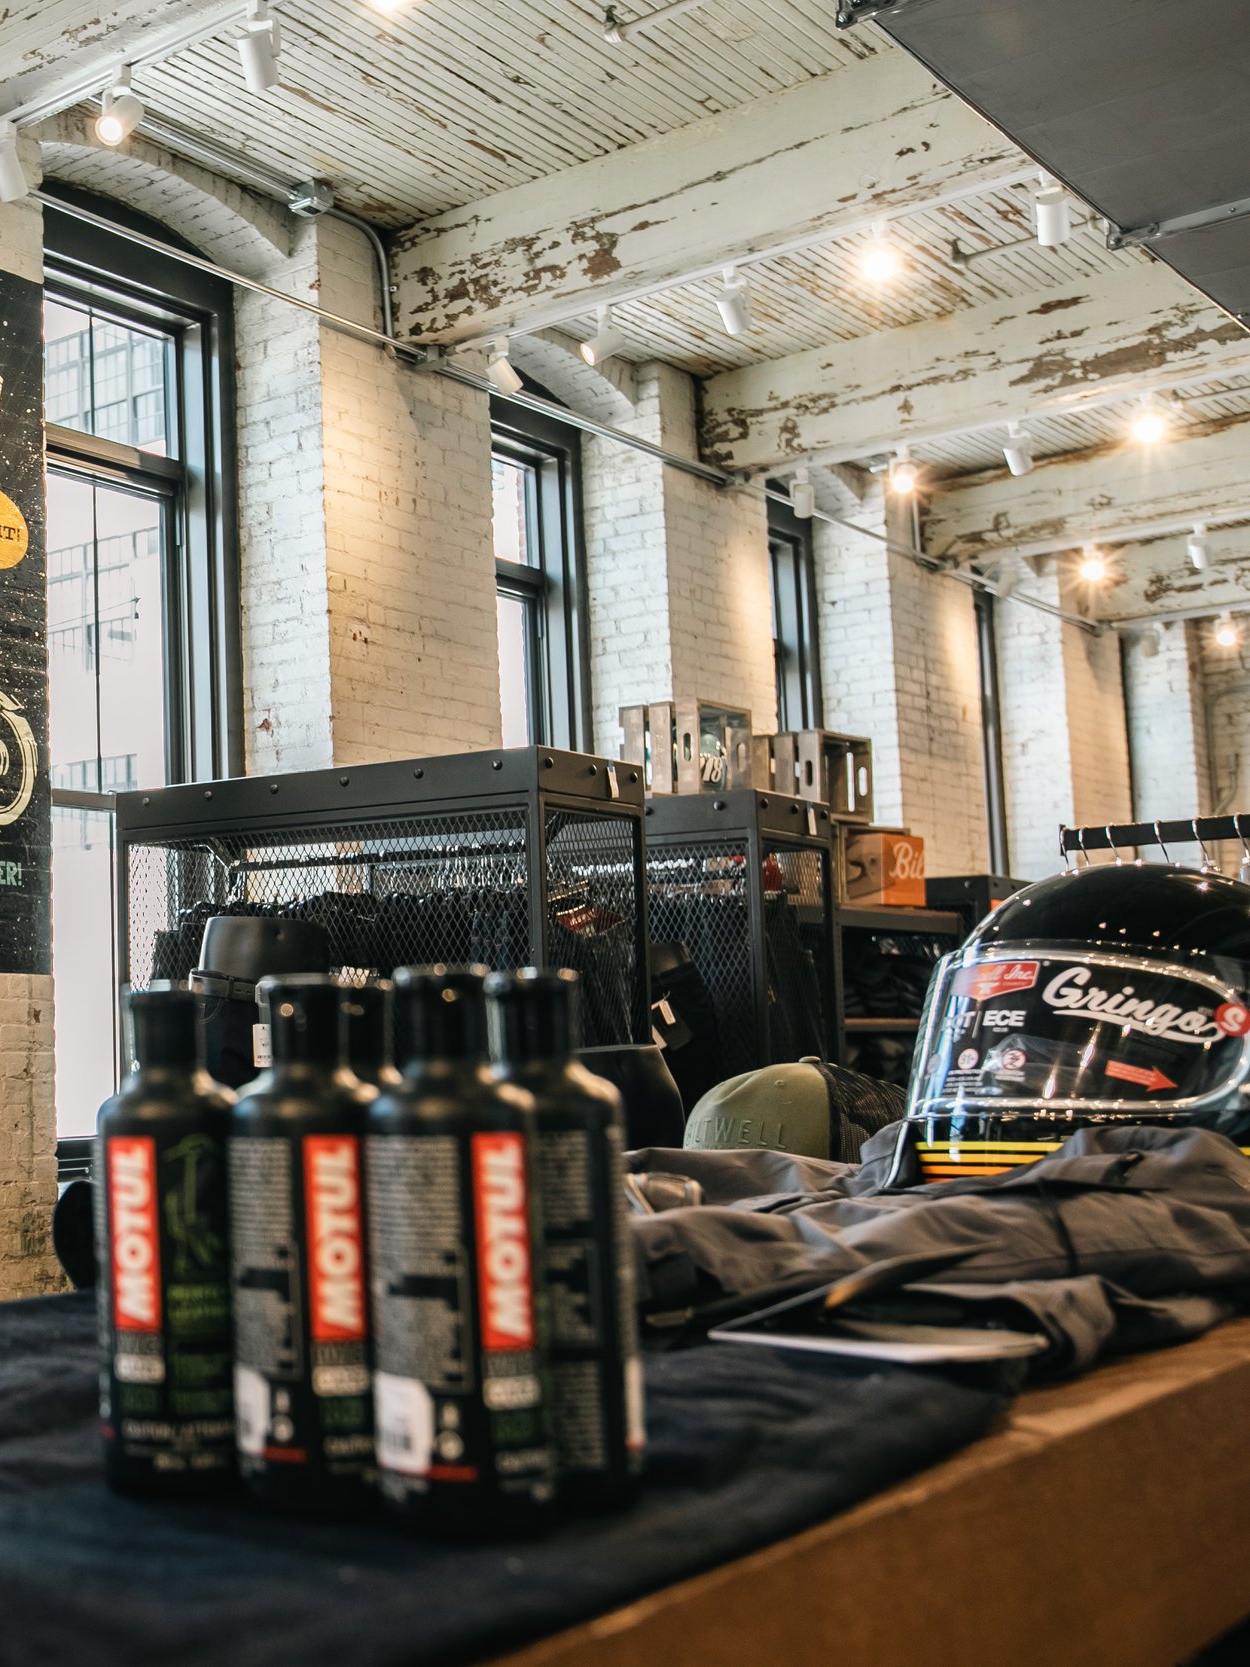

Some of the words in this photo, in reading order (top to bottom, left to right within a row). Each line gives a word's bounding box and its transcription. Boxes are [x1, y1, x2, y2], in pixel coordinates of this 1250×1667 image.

[982, 1009, 1027, 1027] ECE
[1042, 966, 1226, 1043] Gringo
[111, 1145, 154, 1325] MOTUL
[314, 1143, 362, 1330] MOTUL
[482, 1140, 531, 1339] MOTUL
